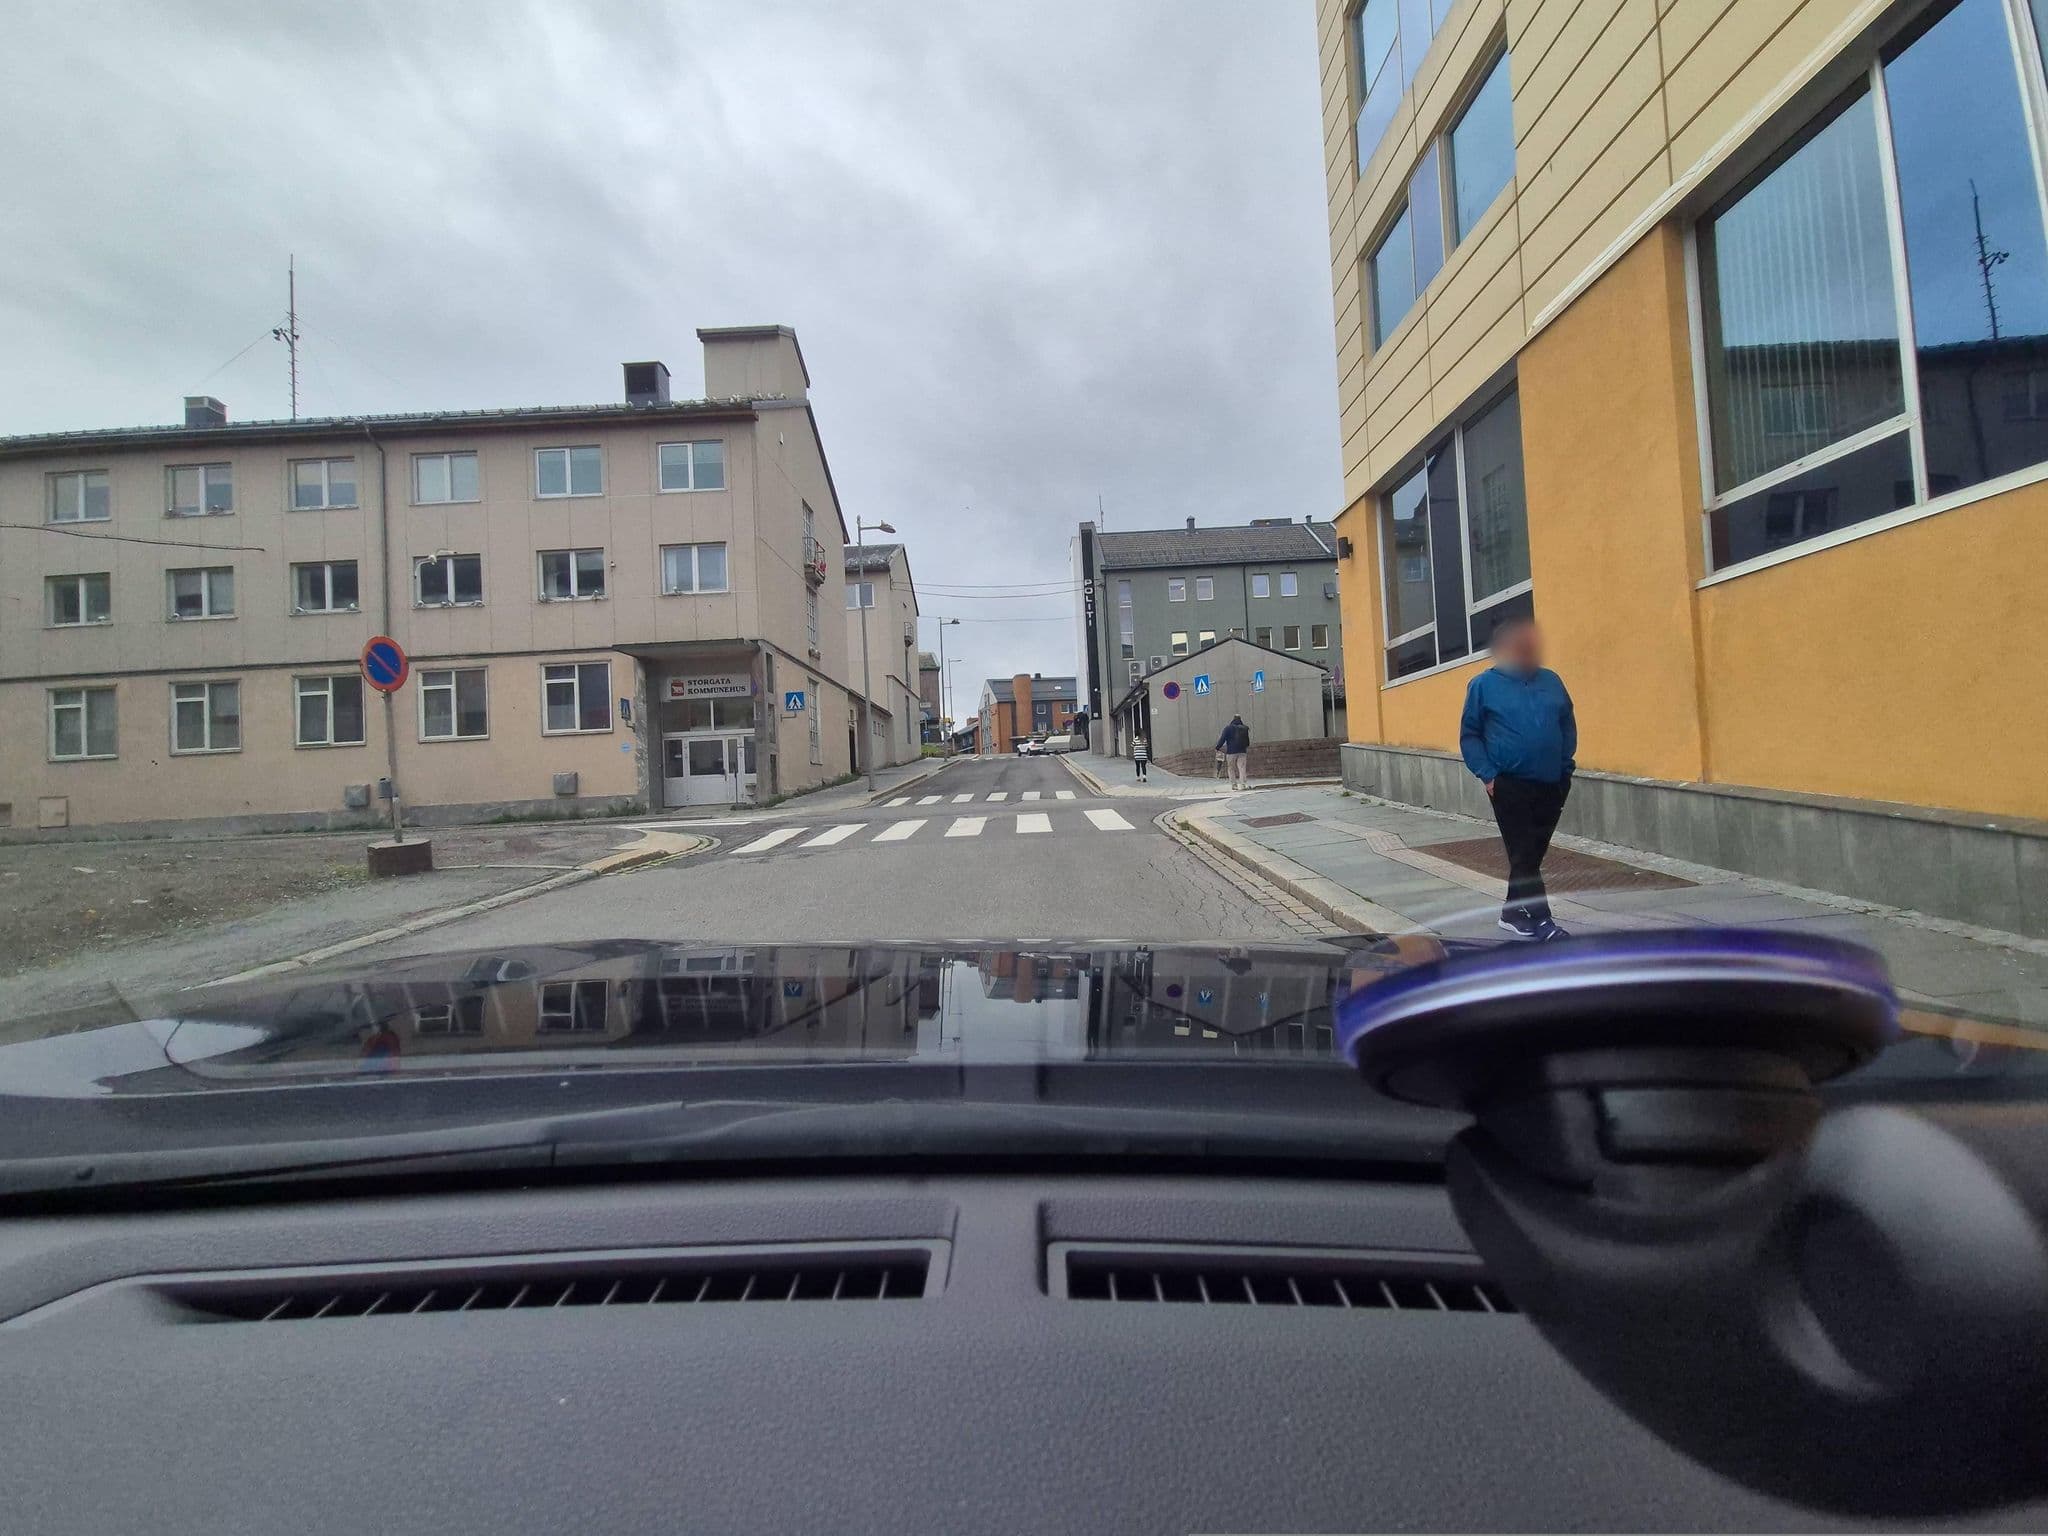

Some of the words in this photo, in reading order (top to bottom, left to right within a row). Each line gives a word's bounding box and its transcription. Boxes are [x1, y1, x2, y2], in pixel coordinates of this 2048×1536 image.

[1084, 578, 1094, 627] POLITI
[687, 678, 731, 686] STORGATA
[687, 686, 746, 695] KOMMUNEHUS
